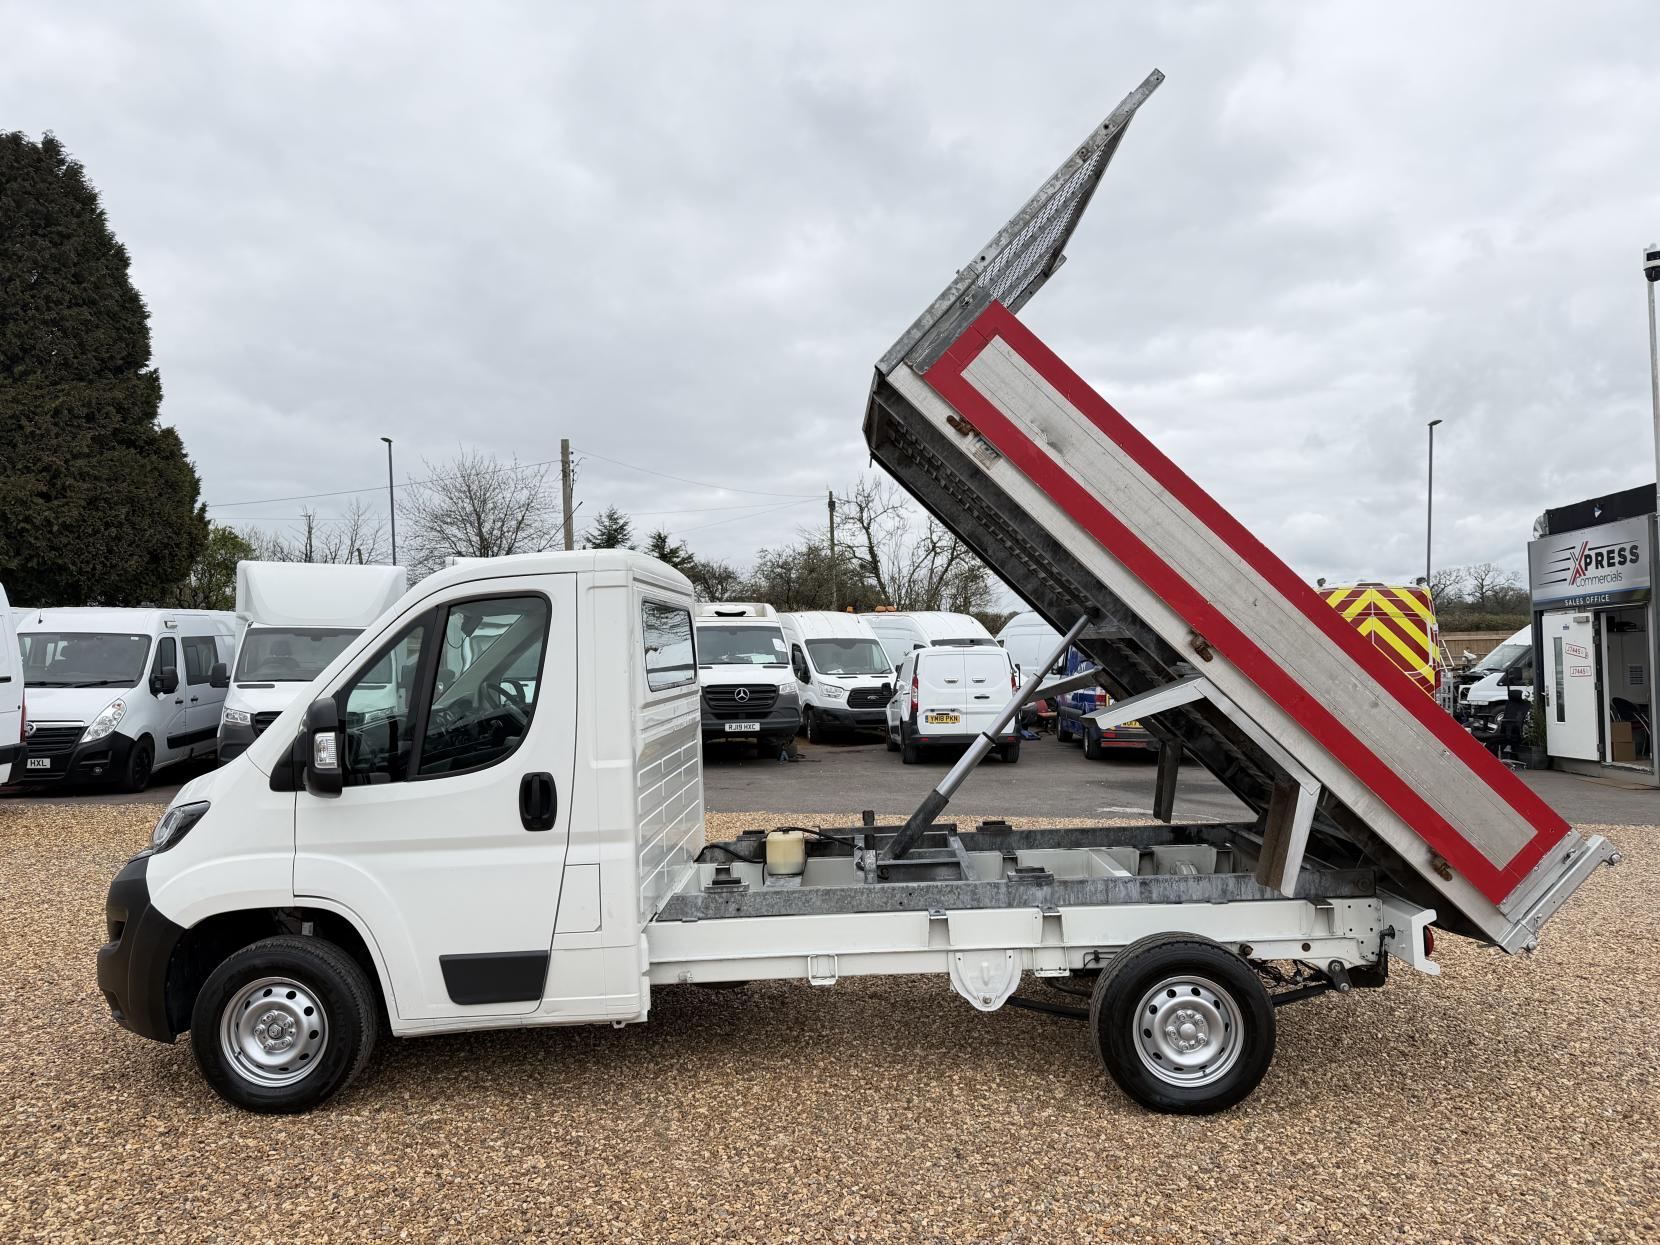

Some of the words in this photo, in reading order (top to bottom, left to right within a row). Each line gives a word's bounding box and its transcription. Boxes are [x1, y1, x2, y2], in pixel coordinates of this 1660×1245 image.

[1569, 541, 1640, 586] XPRESS
[1575, 570, 1623, 588] Commercials
[1564, 597, 1583, 607] SALES
[1585, 594, 1610, 604] OFFICE
[728, 723, 742, 731] RJ19
[30, 759, 47, 767] HXL
